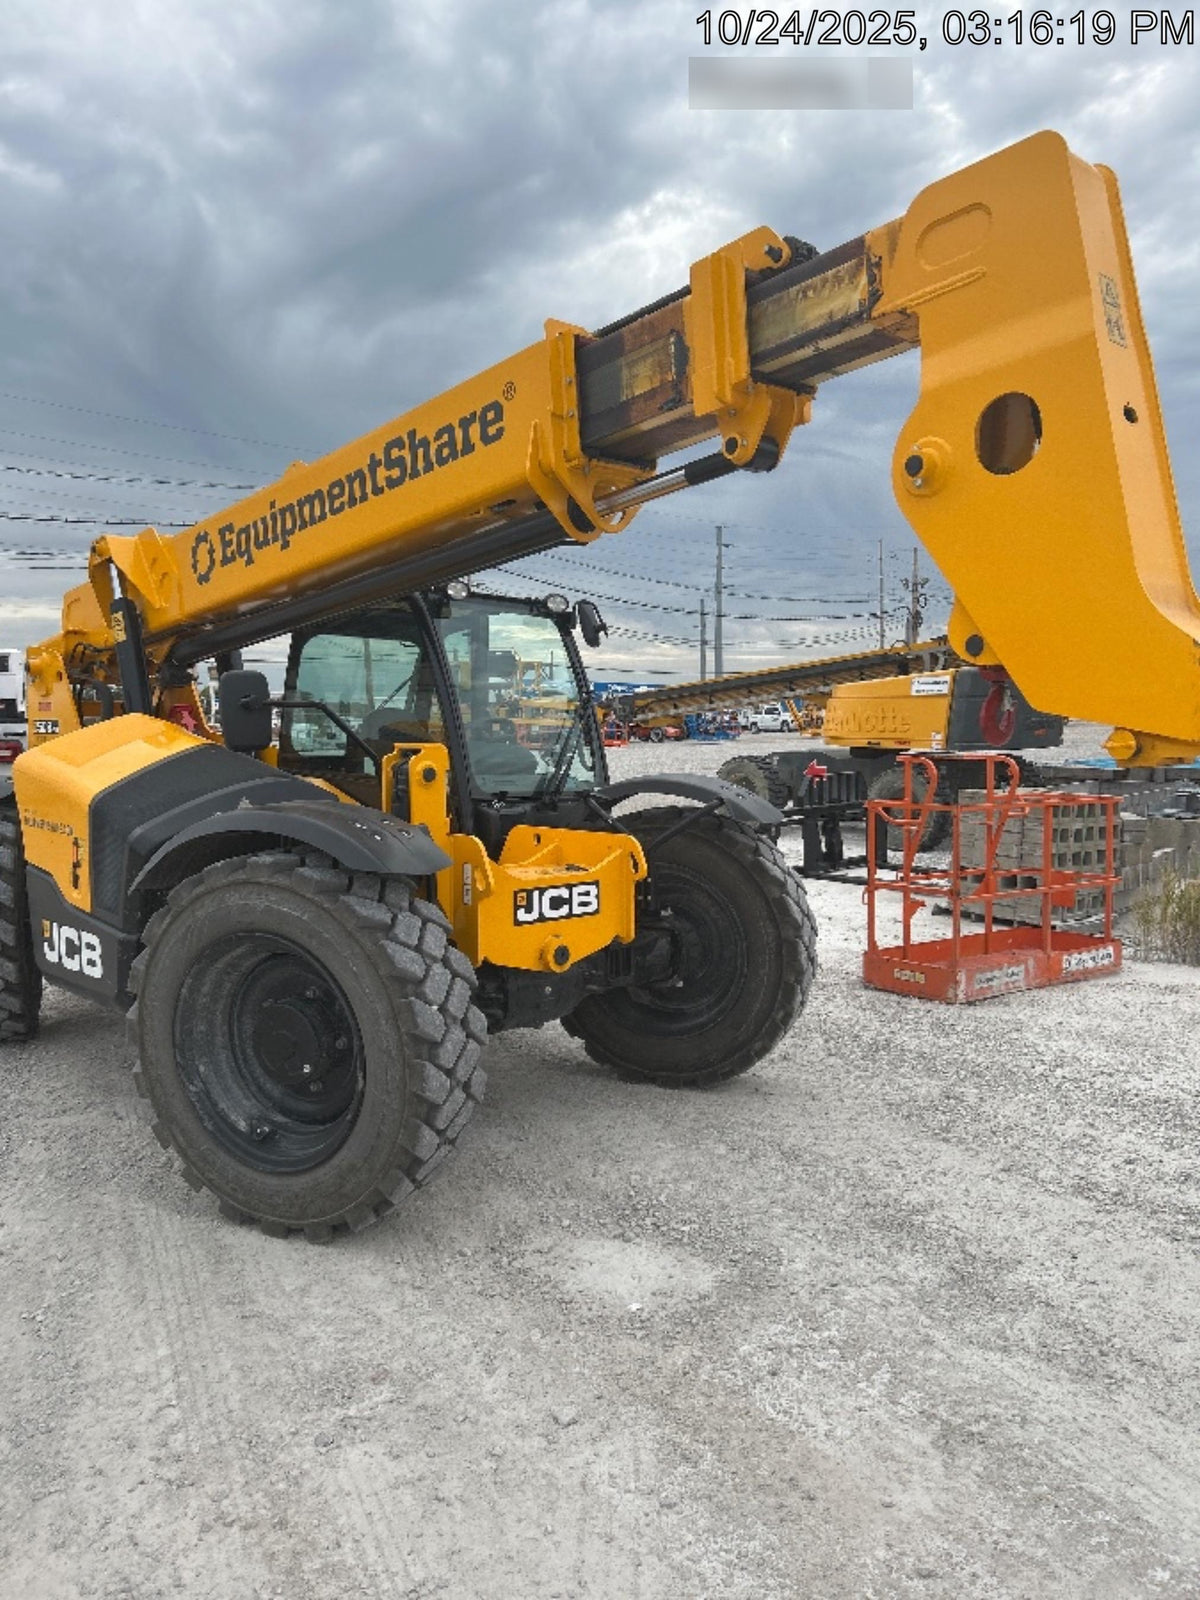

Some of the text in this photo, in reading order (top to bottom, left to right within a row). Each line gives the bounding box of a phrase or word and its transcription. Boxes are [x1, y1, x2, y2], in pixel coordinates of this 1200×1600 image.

[219, 399, 505, 568] EquipmentShare
[516, 885, 598, 921] JCB
[43, 922, 103, 978] JCB
